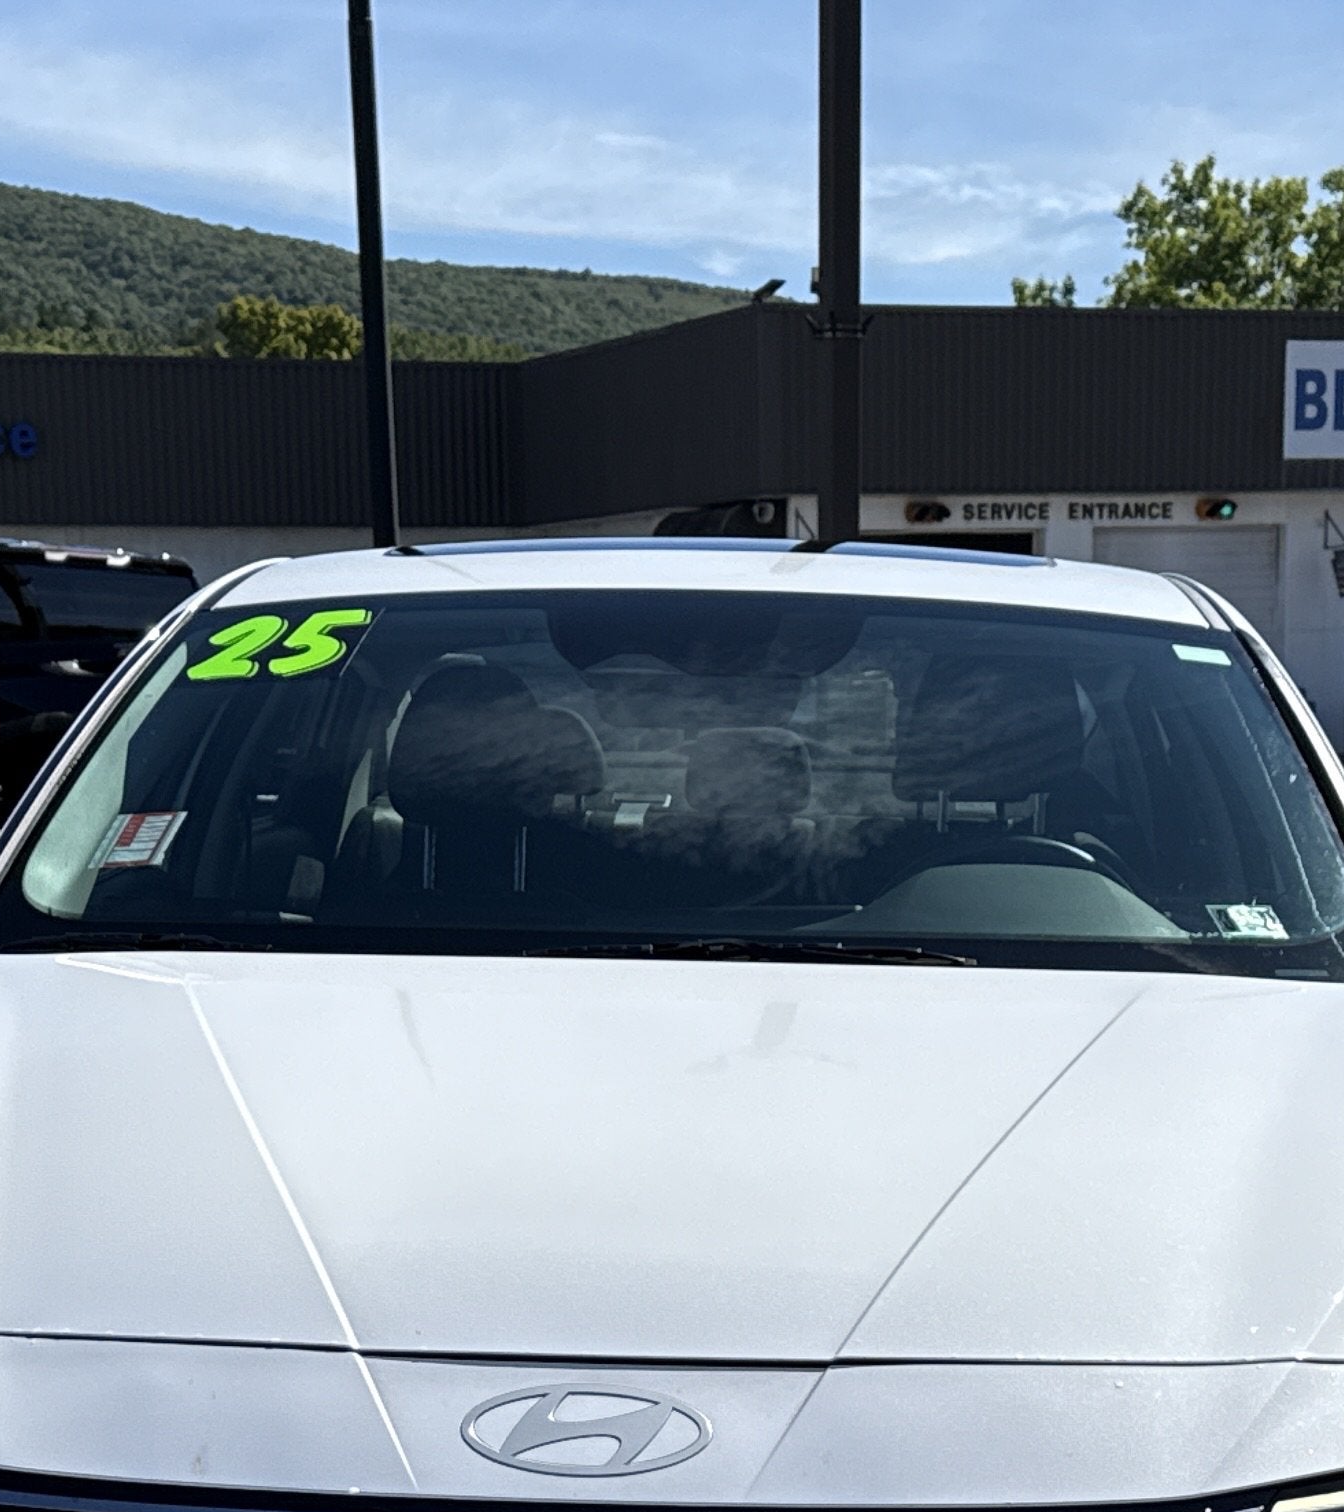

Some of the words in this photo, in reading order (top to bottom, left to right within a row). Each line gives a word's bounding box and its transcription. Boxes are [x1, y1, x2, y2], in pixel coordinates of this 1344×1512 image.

[962, 502, 1050, 521] SERVICE
[1068, 501, 1174, 520] ENTRANCE
[186, 609, 373, 680] 25
